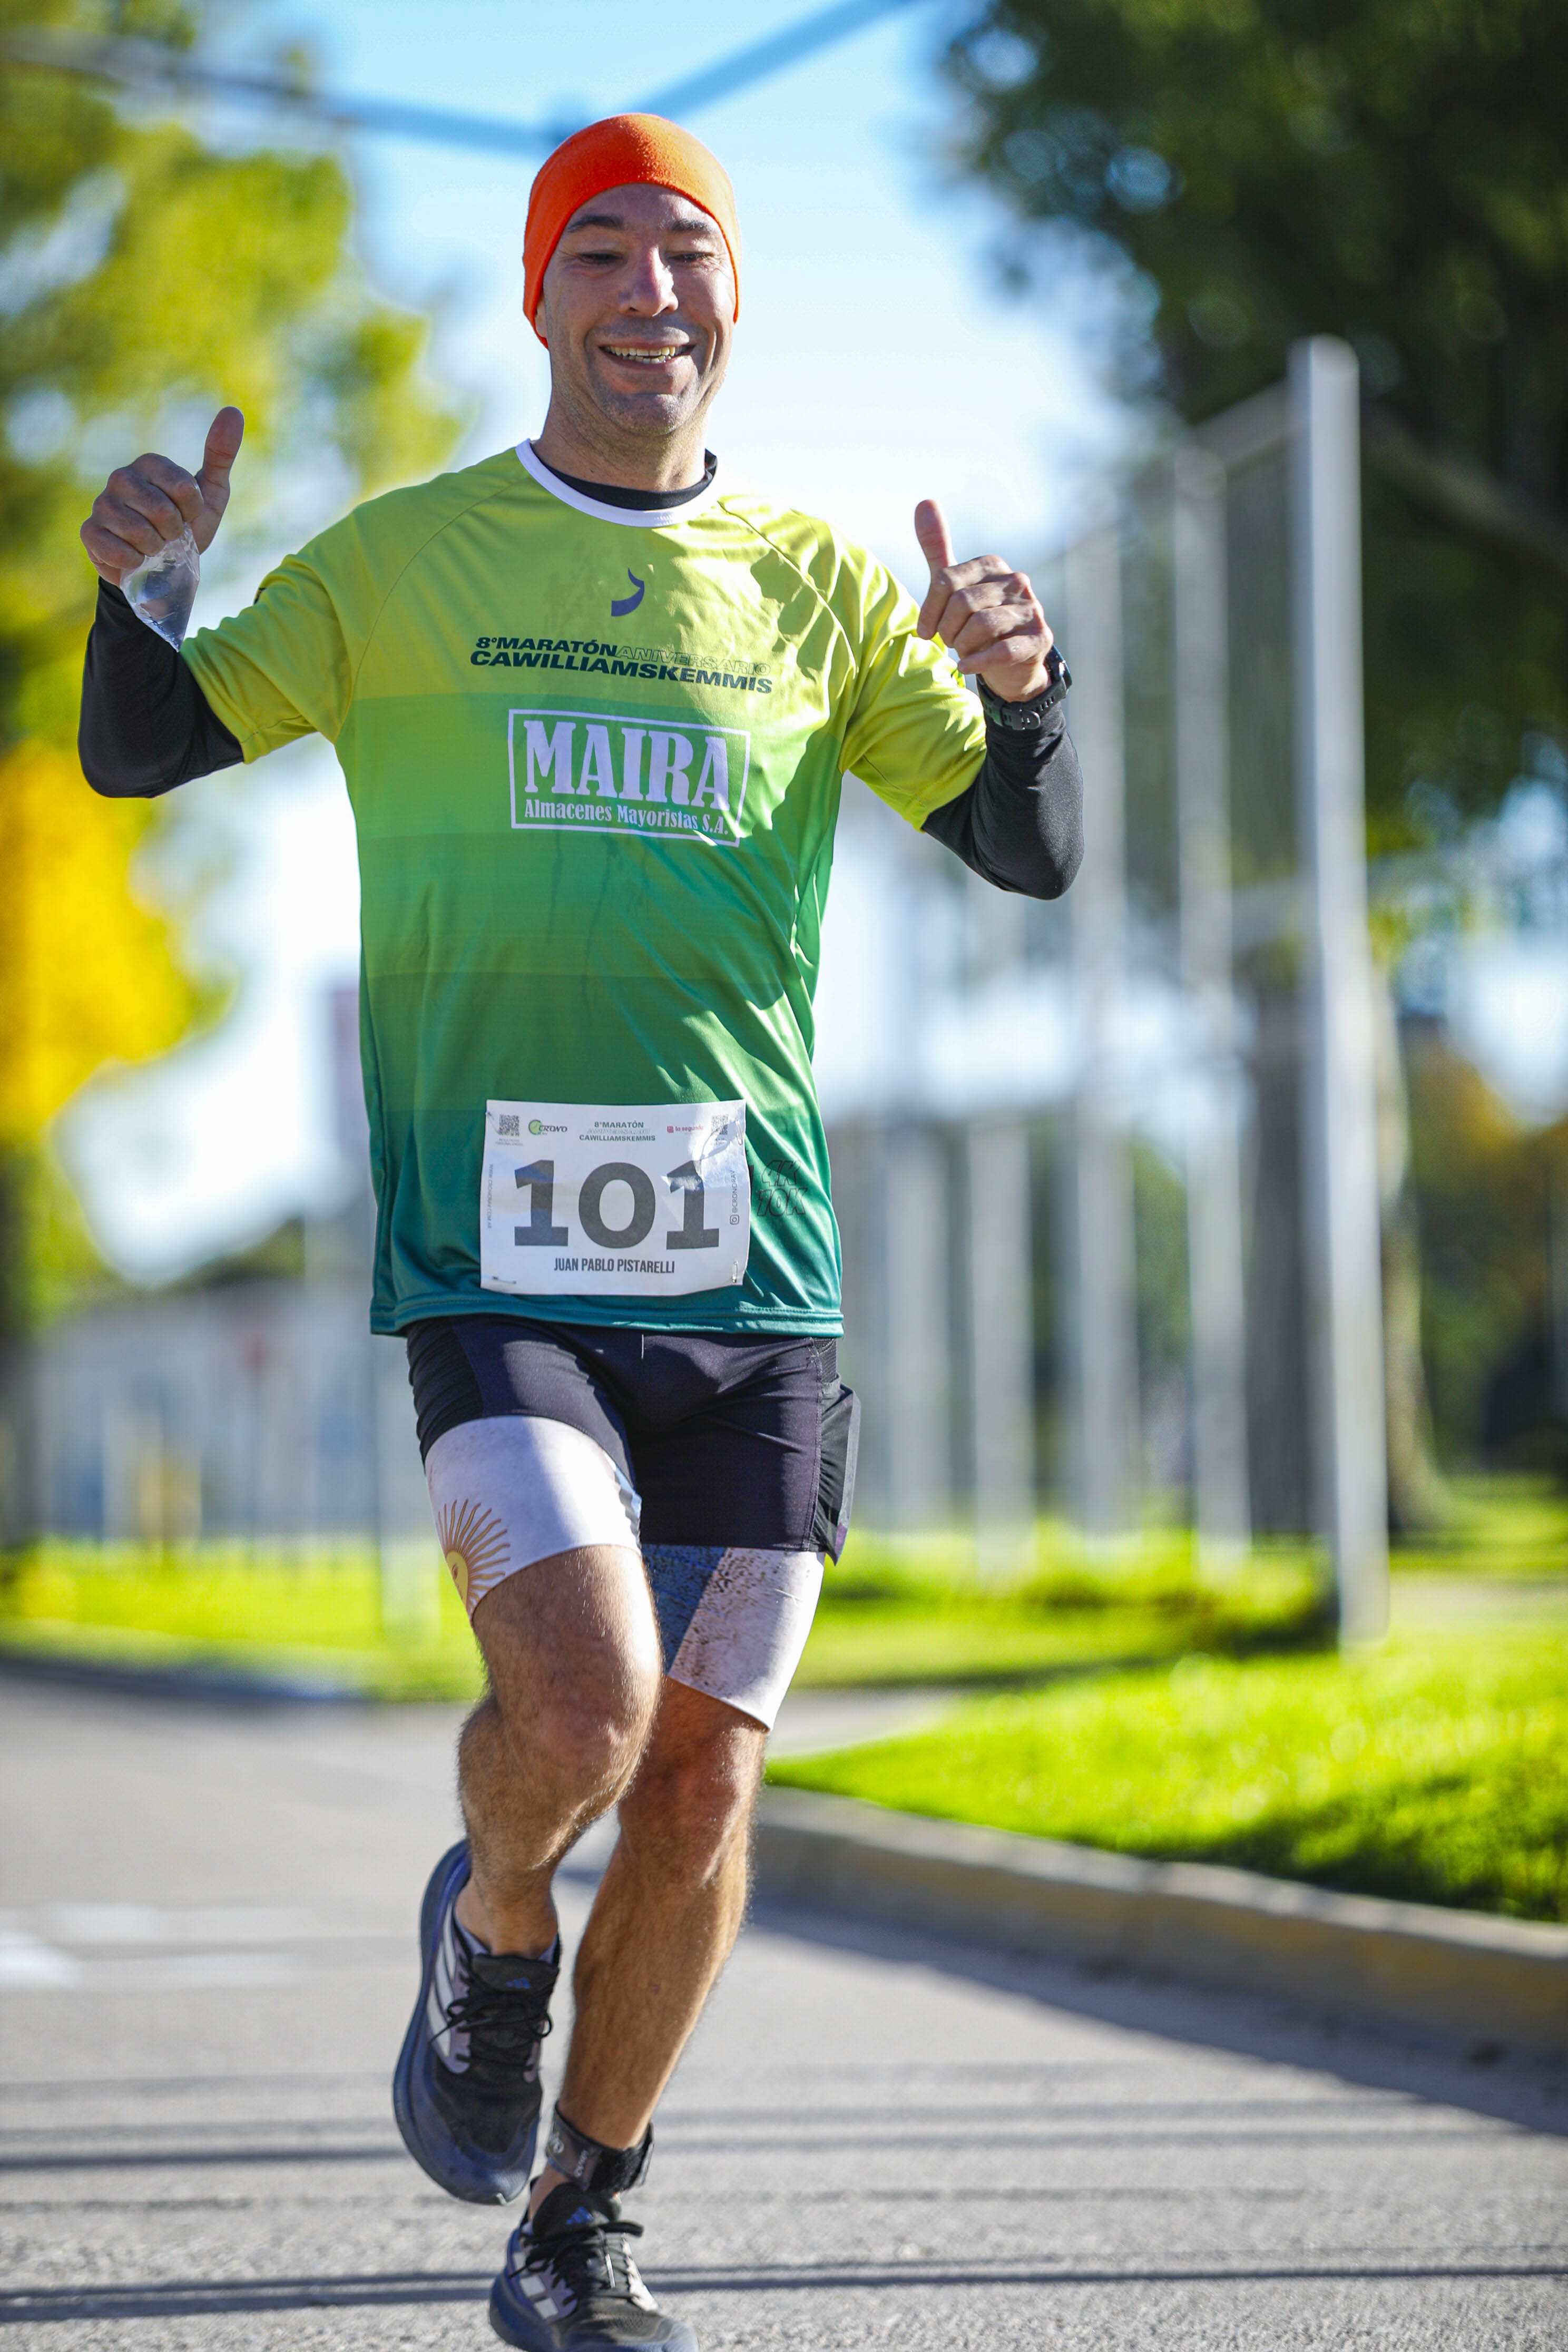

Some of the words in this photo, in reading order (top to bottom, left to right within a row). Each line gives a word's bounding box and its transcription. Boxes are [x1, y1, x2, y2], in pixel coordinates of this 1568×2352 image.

[470, 650, 773, 694] CAWILLIAMSKEMMIS
[523, 720, 730, 811] MAIRA
[524, 799, 612, 822] Almacenes
[616, 804, 699, 830] Mayoristas
[702, 814, 729, 835] S.A.
[761, 1160, 801, 1187] 4K
[514, 1159, 720, 1250] 101
[757, 1188, 808, 1217] 10K
[554, 1258, 579, 1271] JUAN
[581, 1258, 614, 1272] PABLO
[617, 1259, 675, 1273] PISTARELLI
